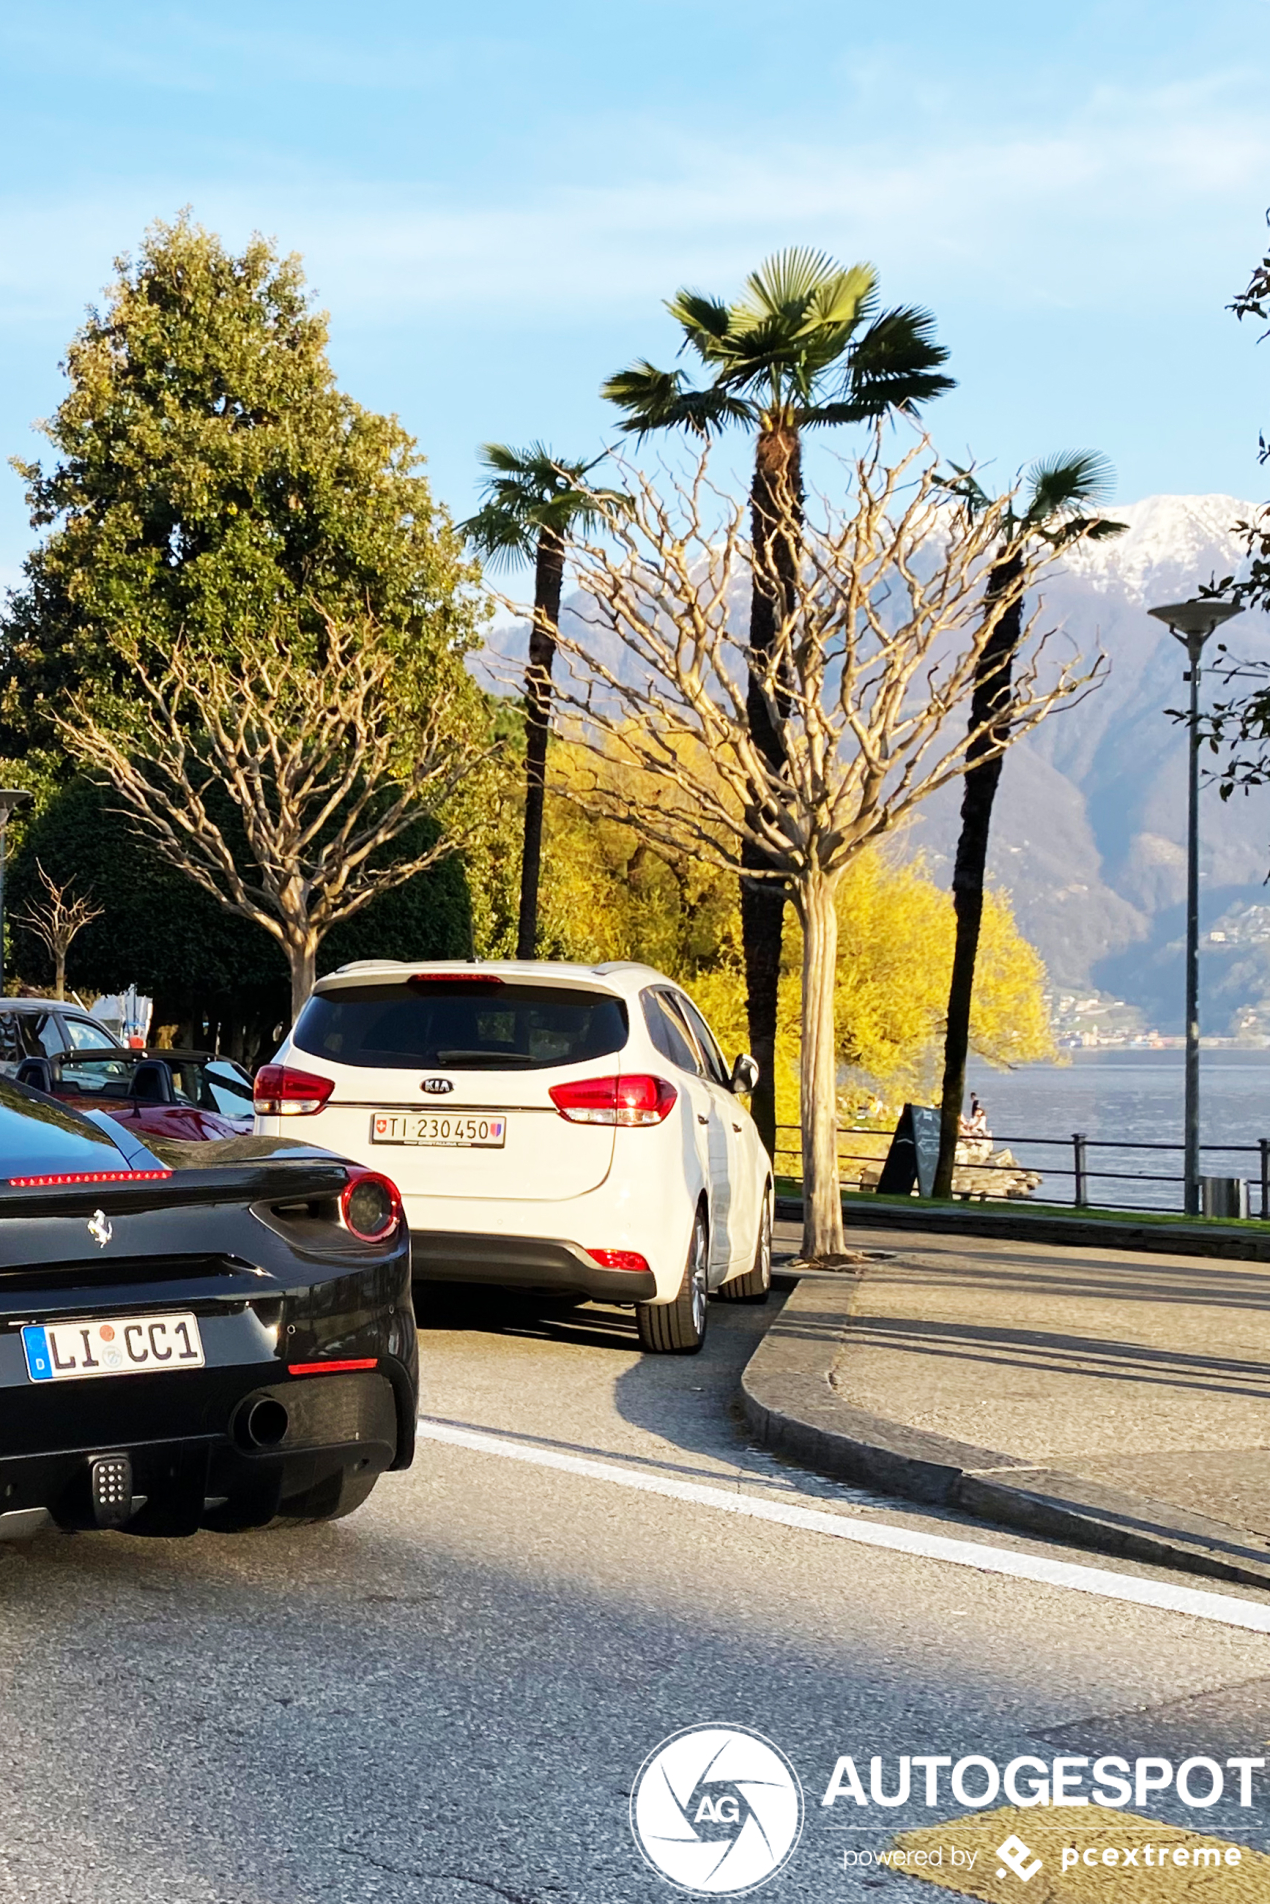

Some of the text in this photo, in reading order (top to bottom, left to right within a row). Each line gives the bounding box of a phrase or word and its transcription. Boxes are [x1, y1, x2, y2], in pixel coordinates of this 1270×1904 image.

[424, 1080, 450, 1092] KIA
[49, 1321, 198, 1370] LI CC1
[36, 1358, 45, 1371] D
